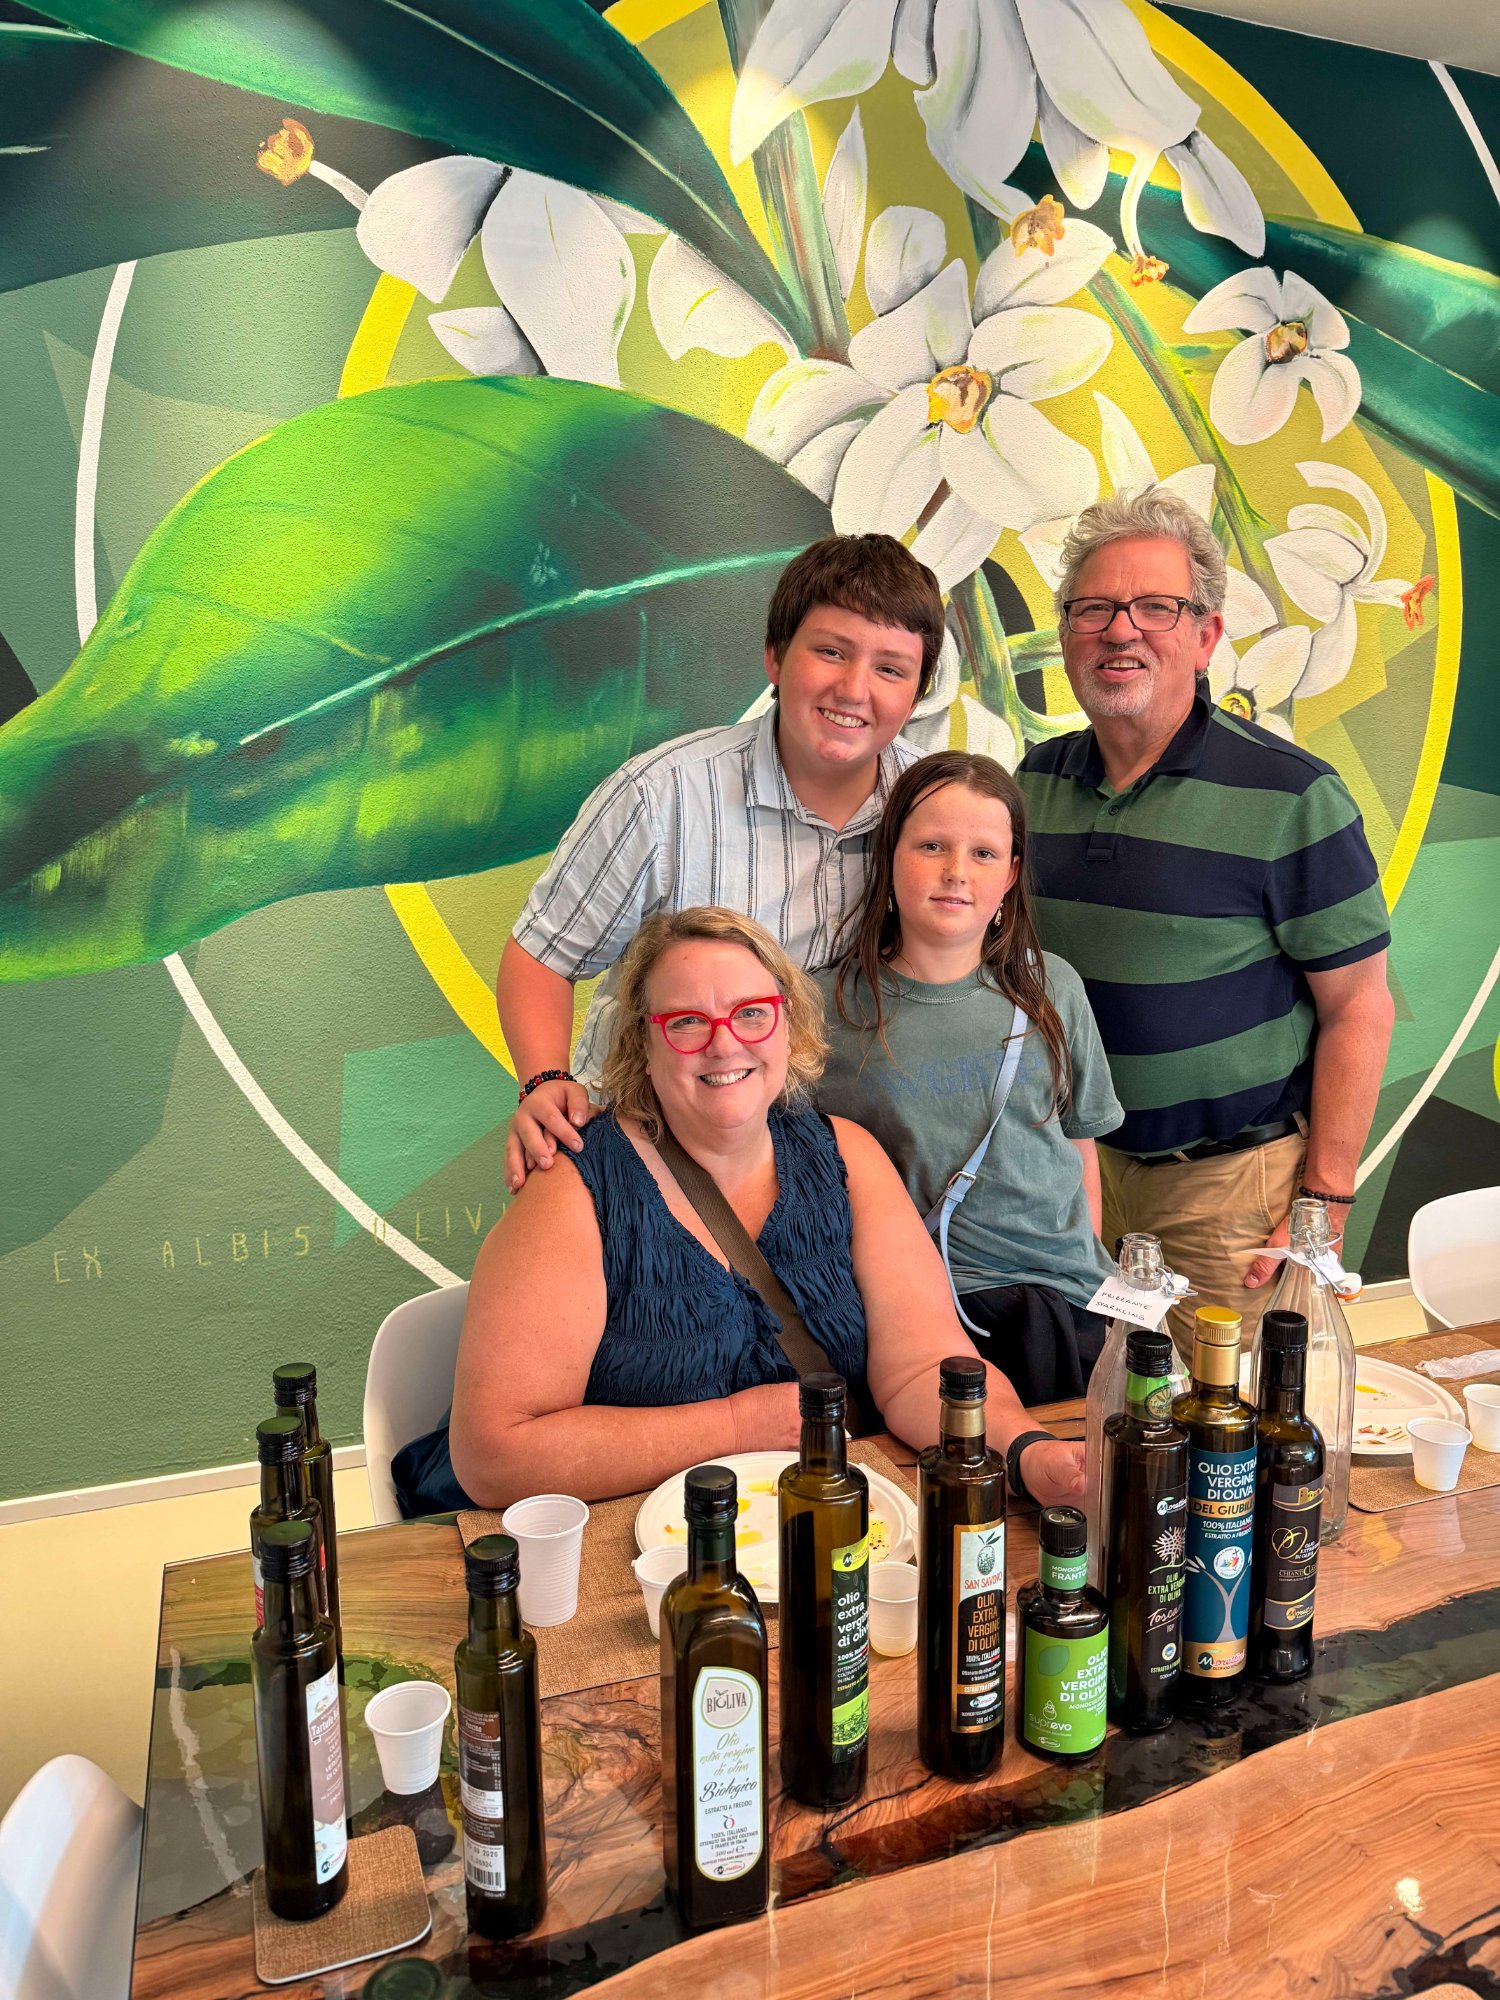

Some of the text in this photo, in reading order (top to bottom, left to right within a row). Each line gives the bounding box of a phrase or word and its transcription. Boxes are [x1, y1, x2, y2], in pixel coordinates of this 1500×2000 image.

[1198, 1456, 1258, 1477] OLIO EXTRA
[1207, 1471, 1255, 1489] VERGINE
[1207, 1484, 1253, 1501] DI OLIVA
[1194, 1501, 1215, 1516] DEL
[1202, 1520, 1225, 1531] 100%
[964, 1578, 981, 1590] SAN
[1147, 1584, 1169, 1595] EXTRA
[837, 1590, 861, 1607] olio
[977, 1592, 996, 1609] OLIO
[837, 1601, 865, 1621] extra
[972, 1605, 999, 1624] EXTRA
[967, 1617, 1001, 1639] VERGINE
[837, 1633, 852, 1649] di
[968, 1631, 1001, 1653] DI OLIVA
[965, 1655, 981, 1663] 100%
[1076, 1658, 1108, 1680] EXTRA
[1060, 1668, 1108, 1691] VERGINE
[1059, 1692, 1075, 1703] DI
[1078, 1680, 1108, 1701] OLIVA
[706, 1691, 749, 1714] BIOLIVA
[716, 1731, 741, 1751] Olio
[699, 1750, 721, 1764] extra
[699, 1777, 758, 1803] Biologico
[704, 1804, 729, 1815] ESTRATTO
[732, 1799, 753, 1809] FREDDO
